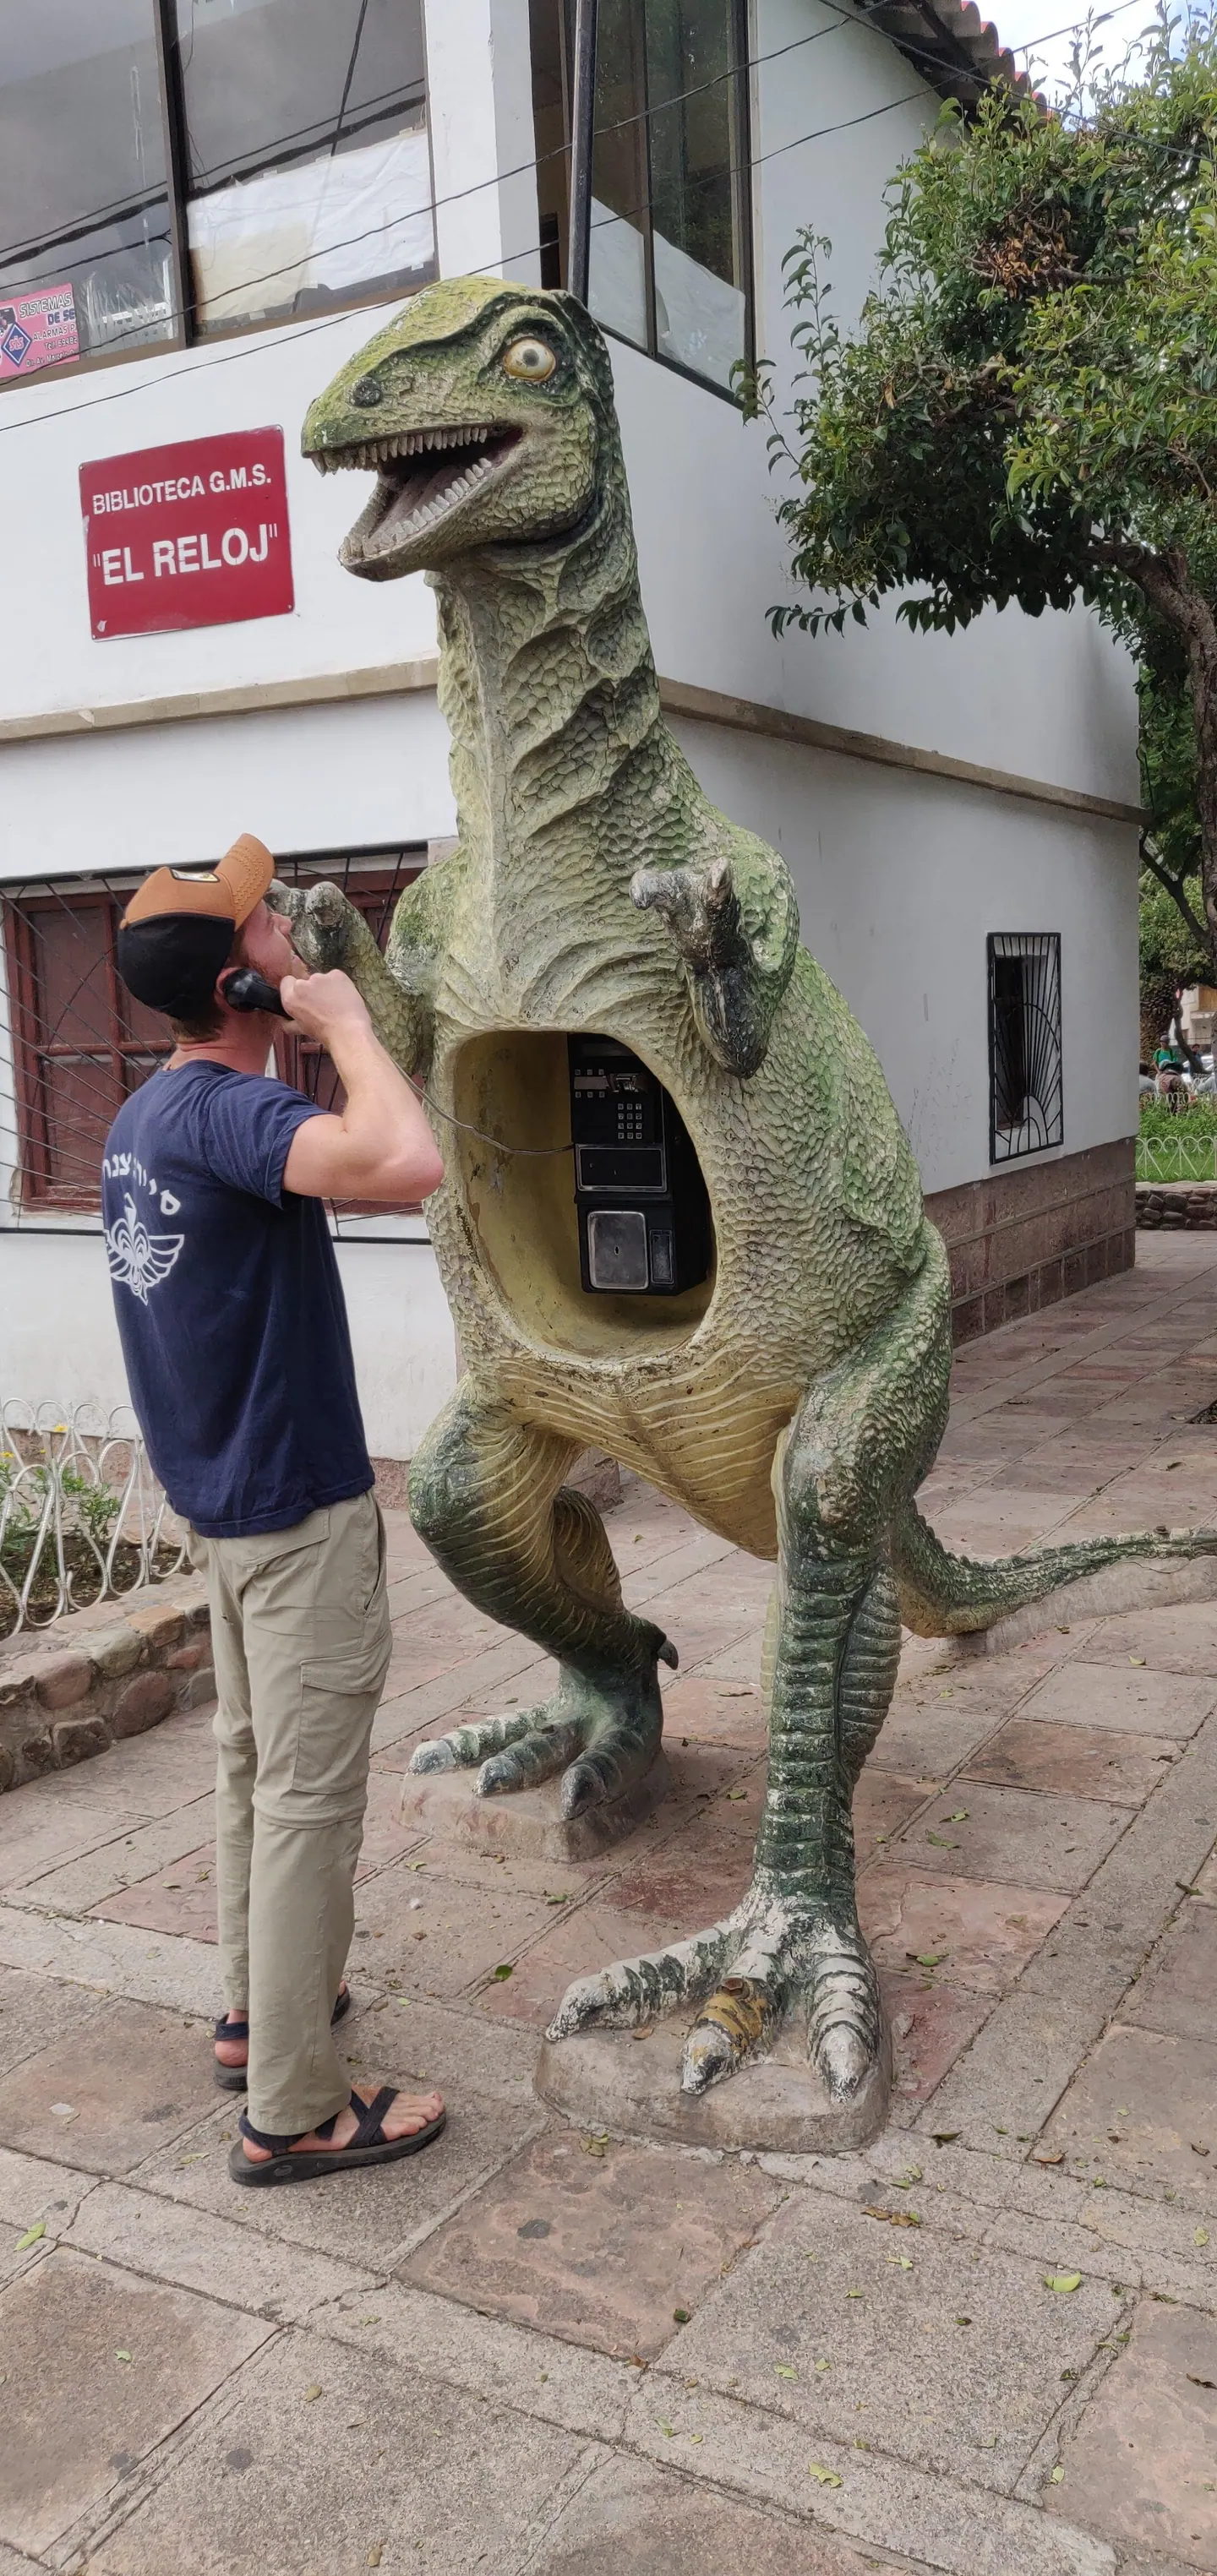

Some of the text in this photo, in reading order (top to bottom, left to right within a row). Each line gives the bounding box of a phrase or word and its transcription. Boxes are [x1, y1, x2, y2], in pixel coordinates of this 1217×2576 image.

[19, 291, 72, 318] SISTEMAS
[47, 312, 61, 325] DE
[33, 325, 68, 340] ALARMAS
[92, 464, 272, 515] BIBLIOTECA G.M.S.
[93, 523, 278, 585] "EL RELOJ"
